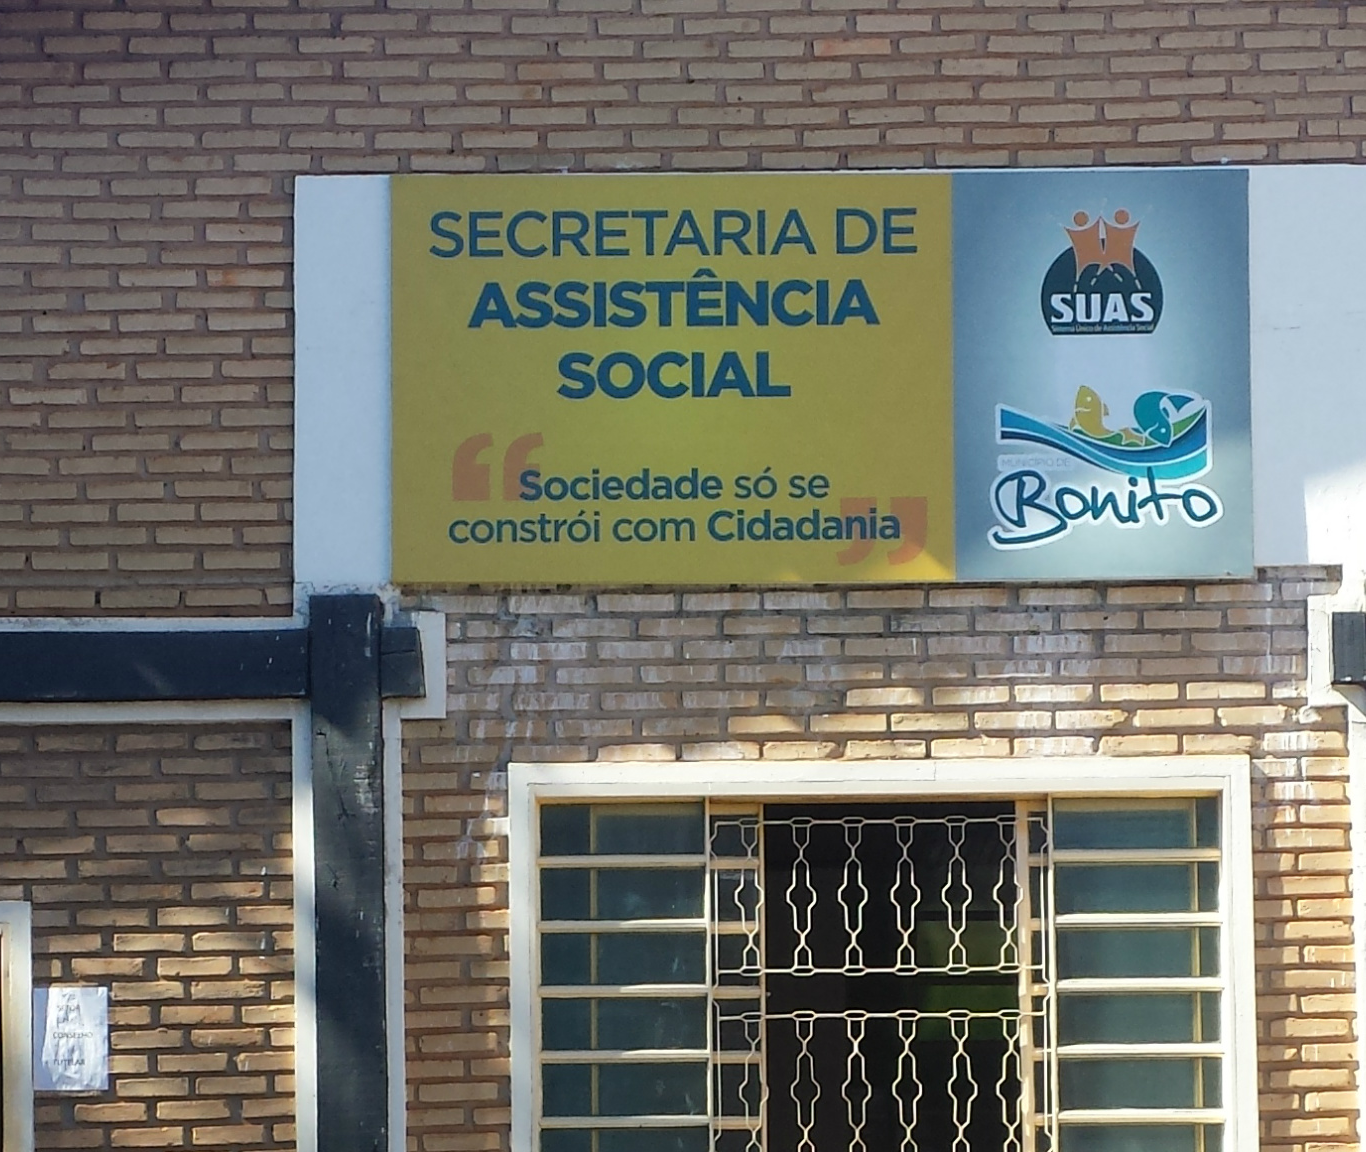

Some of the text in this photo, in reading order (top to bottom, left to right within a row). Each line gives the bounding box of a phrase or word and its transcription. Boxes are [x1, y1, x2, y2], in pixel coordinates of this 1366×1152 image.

[429, 208, 918, 258] SECRETARIA DE
[468, 268, 881, 329] ASSISTÊNCIA
[1050, 292, 1154, 323] SUAS
[557, 351, 792, 399] SOCIAL
[519, 466, 830, 501] Sociedade só se
[992, 466, 1218, 544] Bonito
[448, 507, 901, 544] constrói com Cidadania
